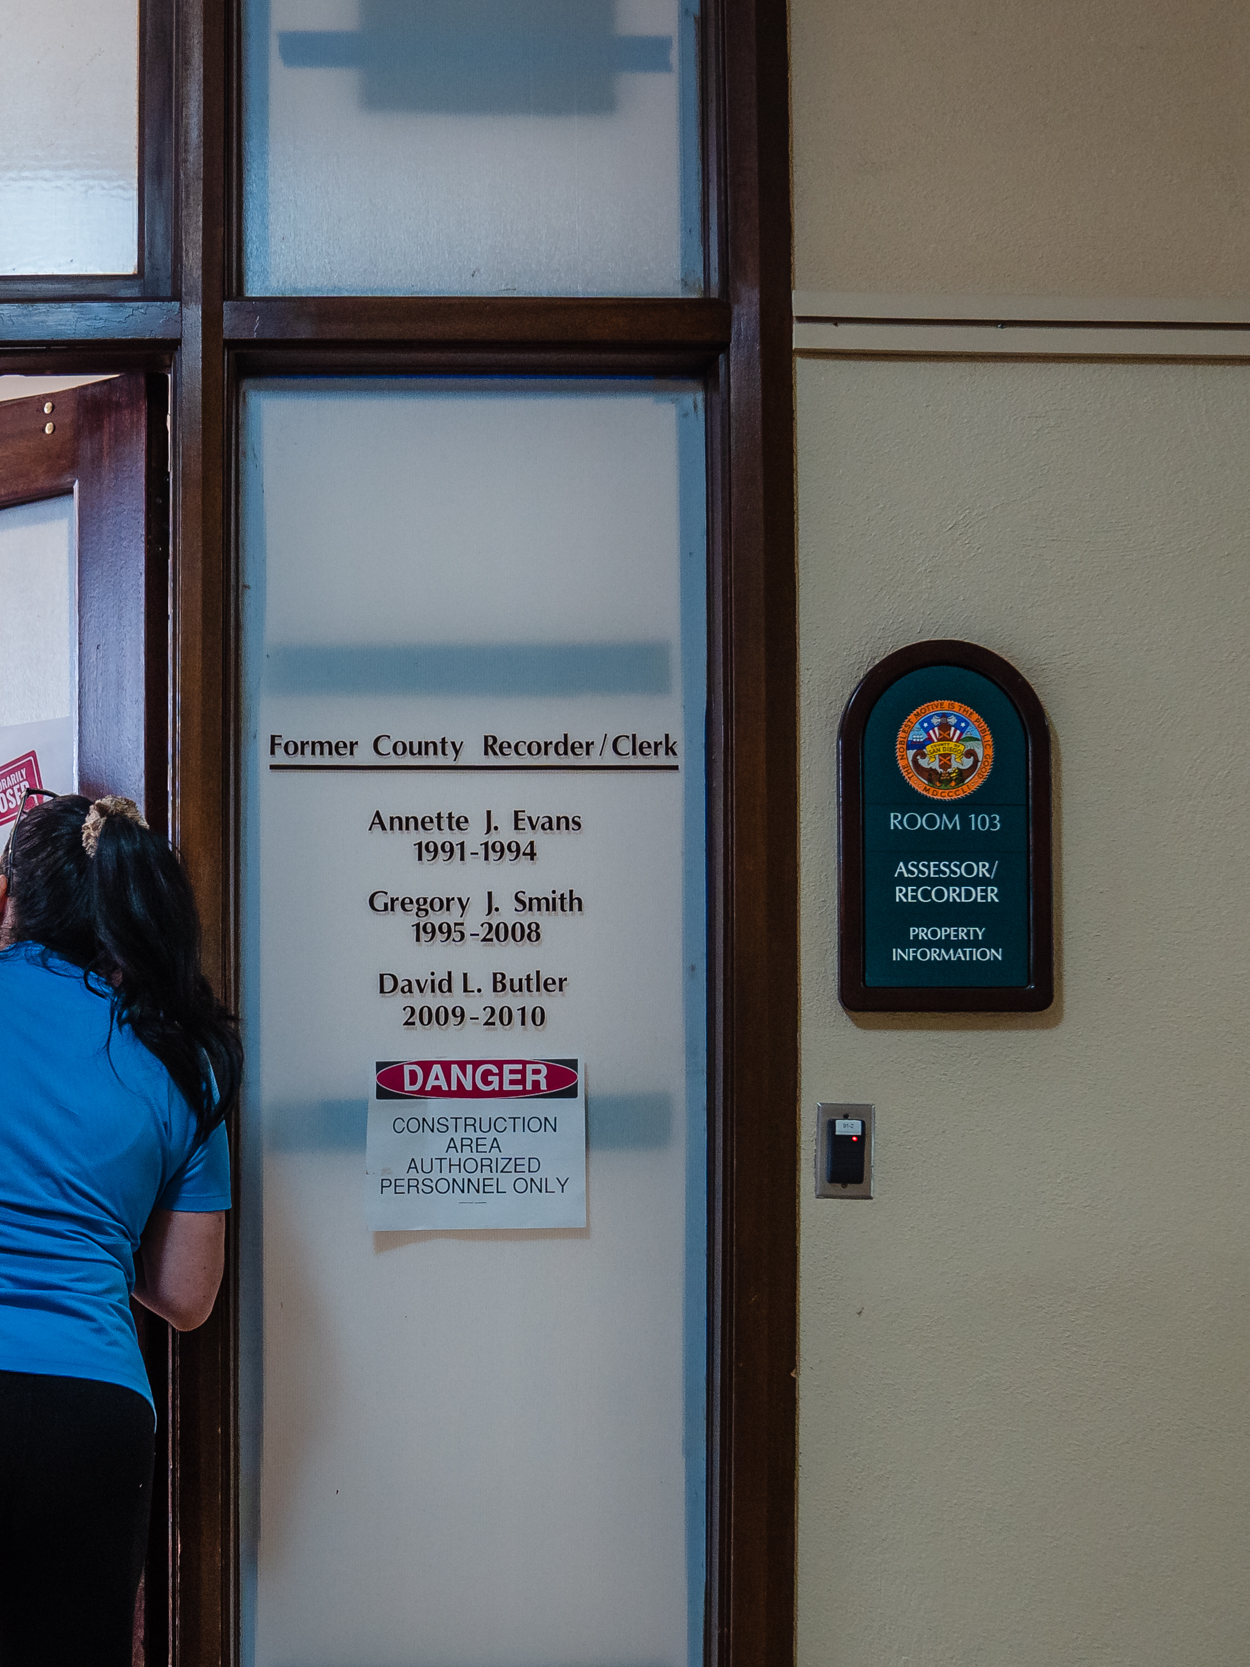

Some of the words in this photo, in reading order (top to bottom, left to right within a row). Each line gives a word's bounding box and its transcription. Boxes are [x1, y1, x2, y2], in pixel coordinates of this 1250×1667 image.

[914, 702, 945, 720] MOTIVE
[948, 702, 955, 710] IS
[958, 705, 974, 718] THE
[898, 720, 914, 761] NOBLEST
[974, 719, 991, 750] PUBLIC
[269, 734, 359, 757] Former
[372, 734, 464, 762] County
[902, 764, 914, 780] THE
[977, 754, 991, 780] GOOD
[368, 810, 469, 832] Annette
[484, 810, 499, 835] J.
[513, 810, 582, 832] Evans
[890, 813, 961, 831] ROOM
[968, 813, 1001, 831] 103
[413, 840, 537, 862] 1991-1994
[894, 860, 999, 880] ASSESSOR/
[368, 890, 470, 917] Gregory
[485, 891, 500, 916] J.
[514, 890, 583, 913] Smith
[895, 887, 999, 903] RECORDER
[411, 921, 541, 943] 1995-2008
[909, 927, 986, 941] PROPERTY
[892, 948, 1003, 962] INFORMATION
[378, 970, 453, 994] David
[462, 973, 483, 994] L.
[491, 972, 568, 994] Butler
[402, 1005, 546, 1027] 2009-2010
[403, 1064, 547, 1091] DANGER
[392, 1116, 557, 1134] CONSTRUCTION
[445, 1137, 502, 1154] AREA
[406, 1157, 541, 1174] AUTHORIZED
[380, 1177, 506, 1195] PERSONNEL
[513, 1177, 570, 1194] ONLY
